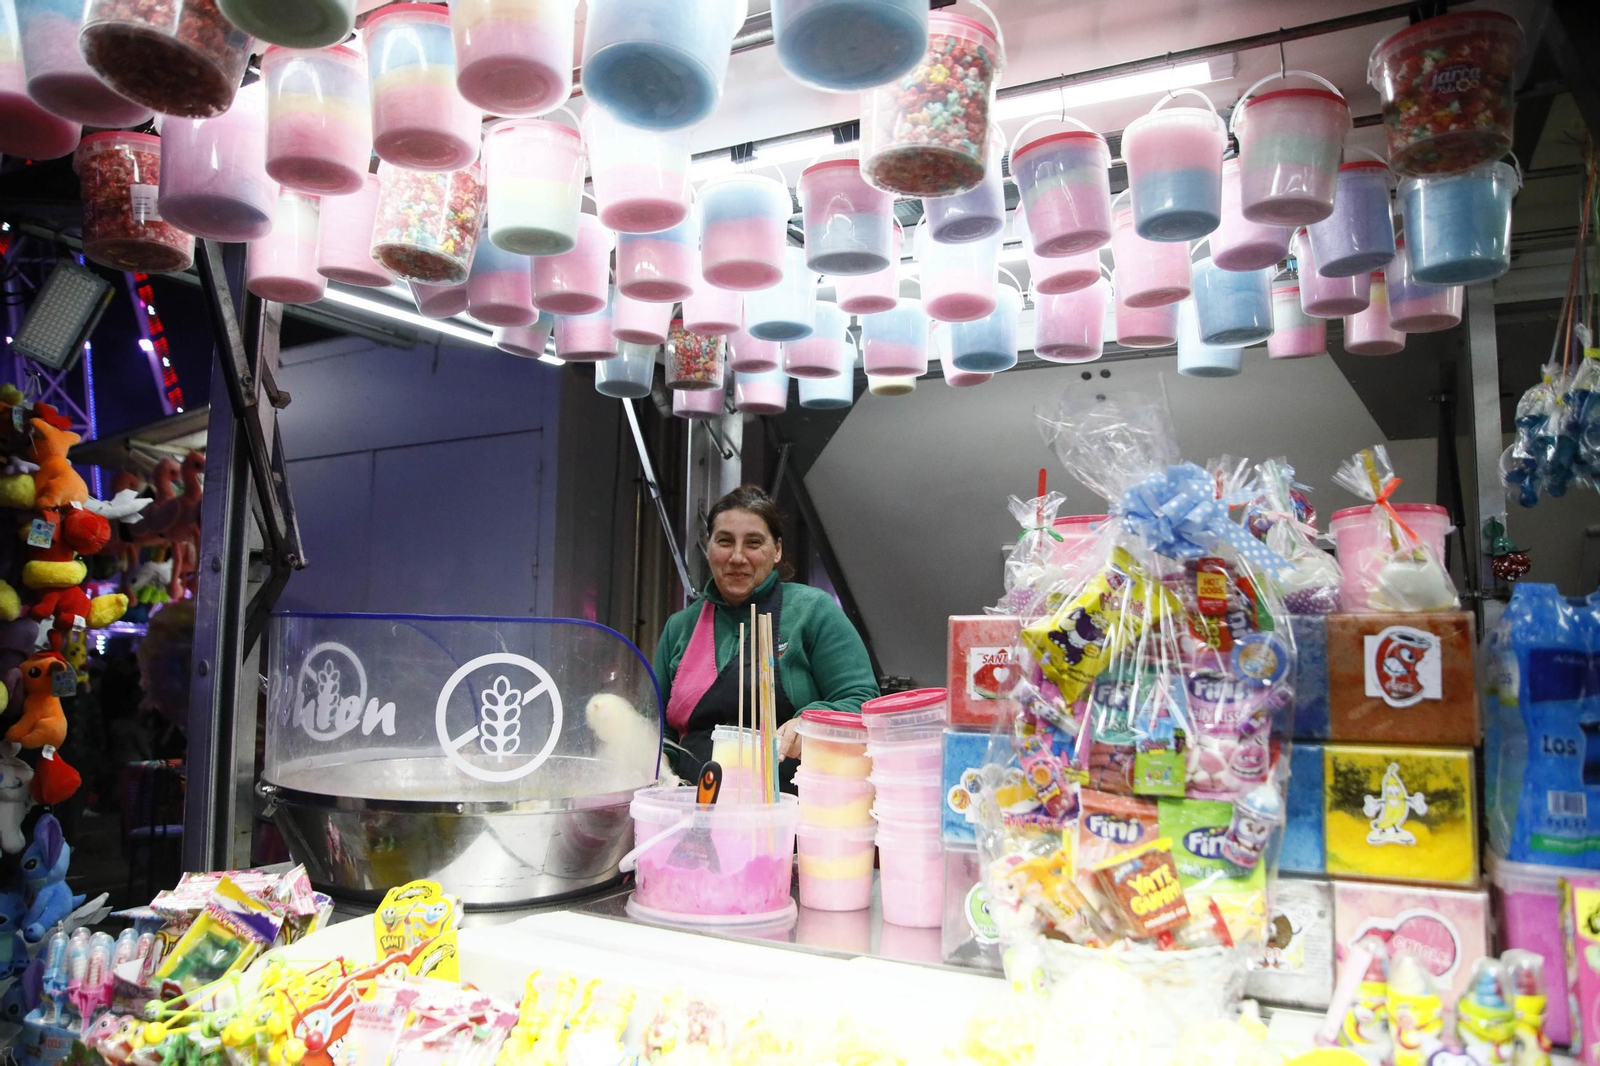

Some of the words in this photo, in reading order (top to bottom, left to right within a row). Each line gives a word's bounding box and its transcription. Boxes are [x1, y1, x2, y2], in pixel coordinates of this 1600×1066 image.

[1200, 586, 1223, 595] DOGS
[1203, 577, 1220, 586] HOT
[1089, 815, 1139, 842] Fini
[1188, 831, 1226, 856] Fin
[1126, 863, 1173, 896] YATE
[1393, 935, 1449, 967] CHICLE
